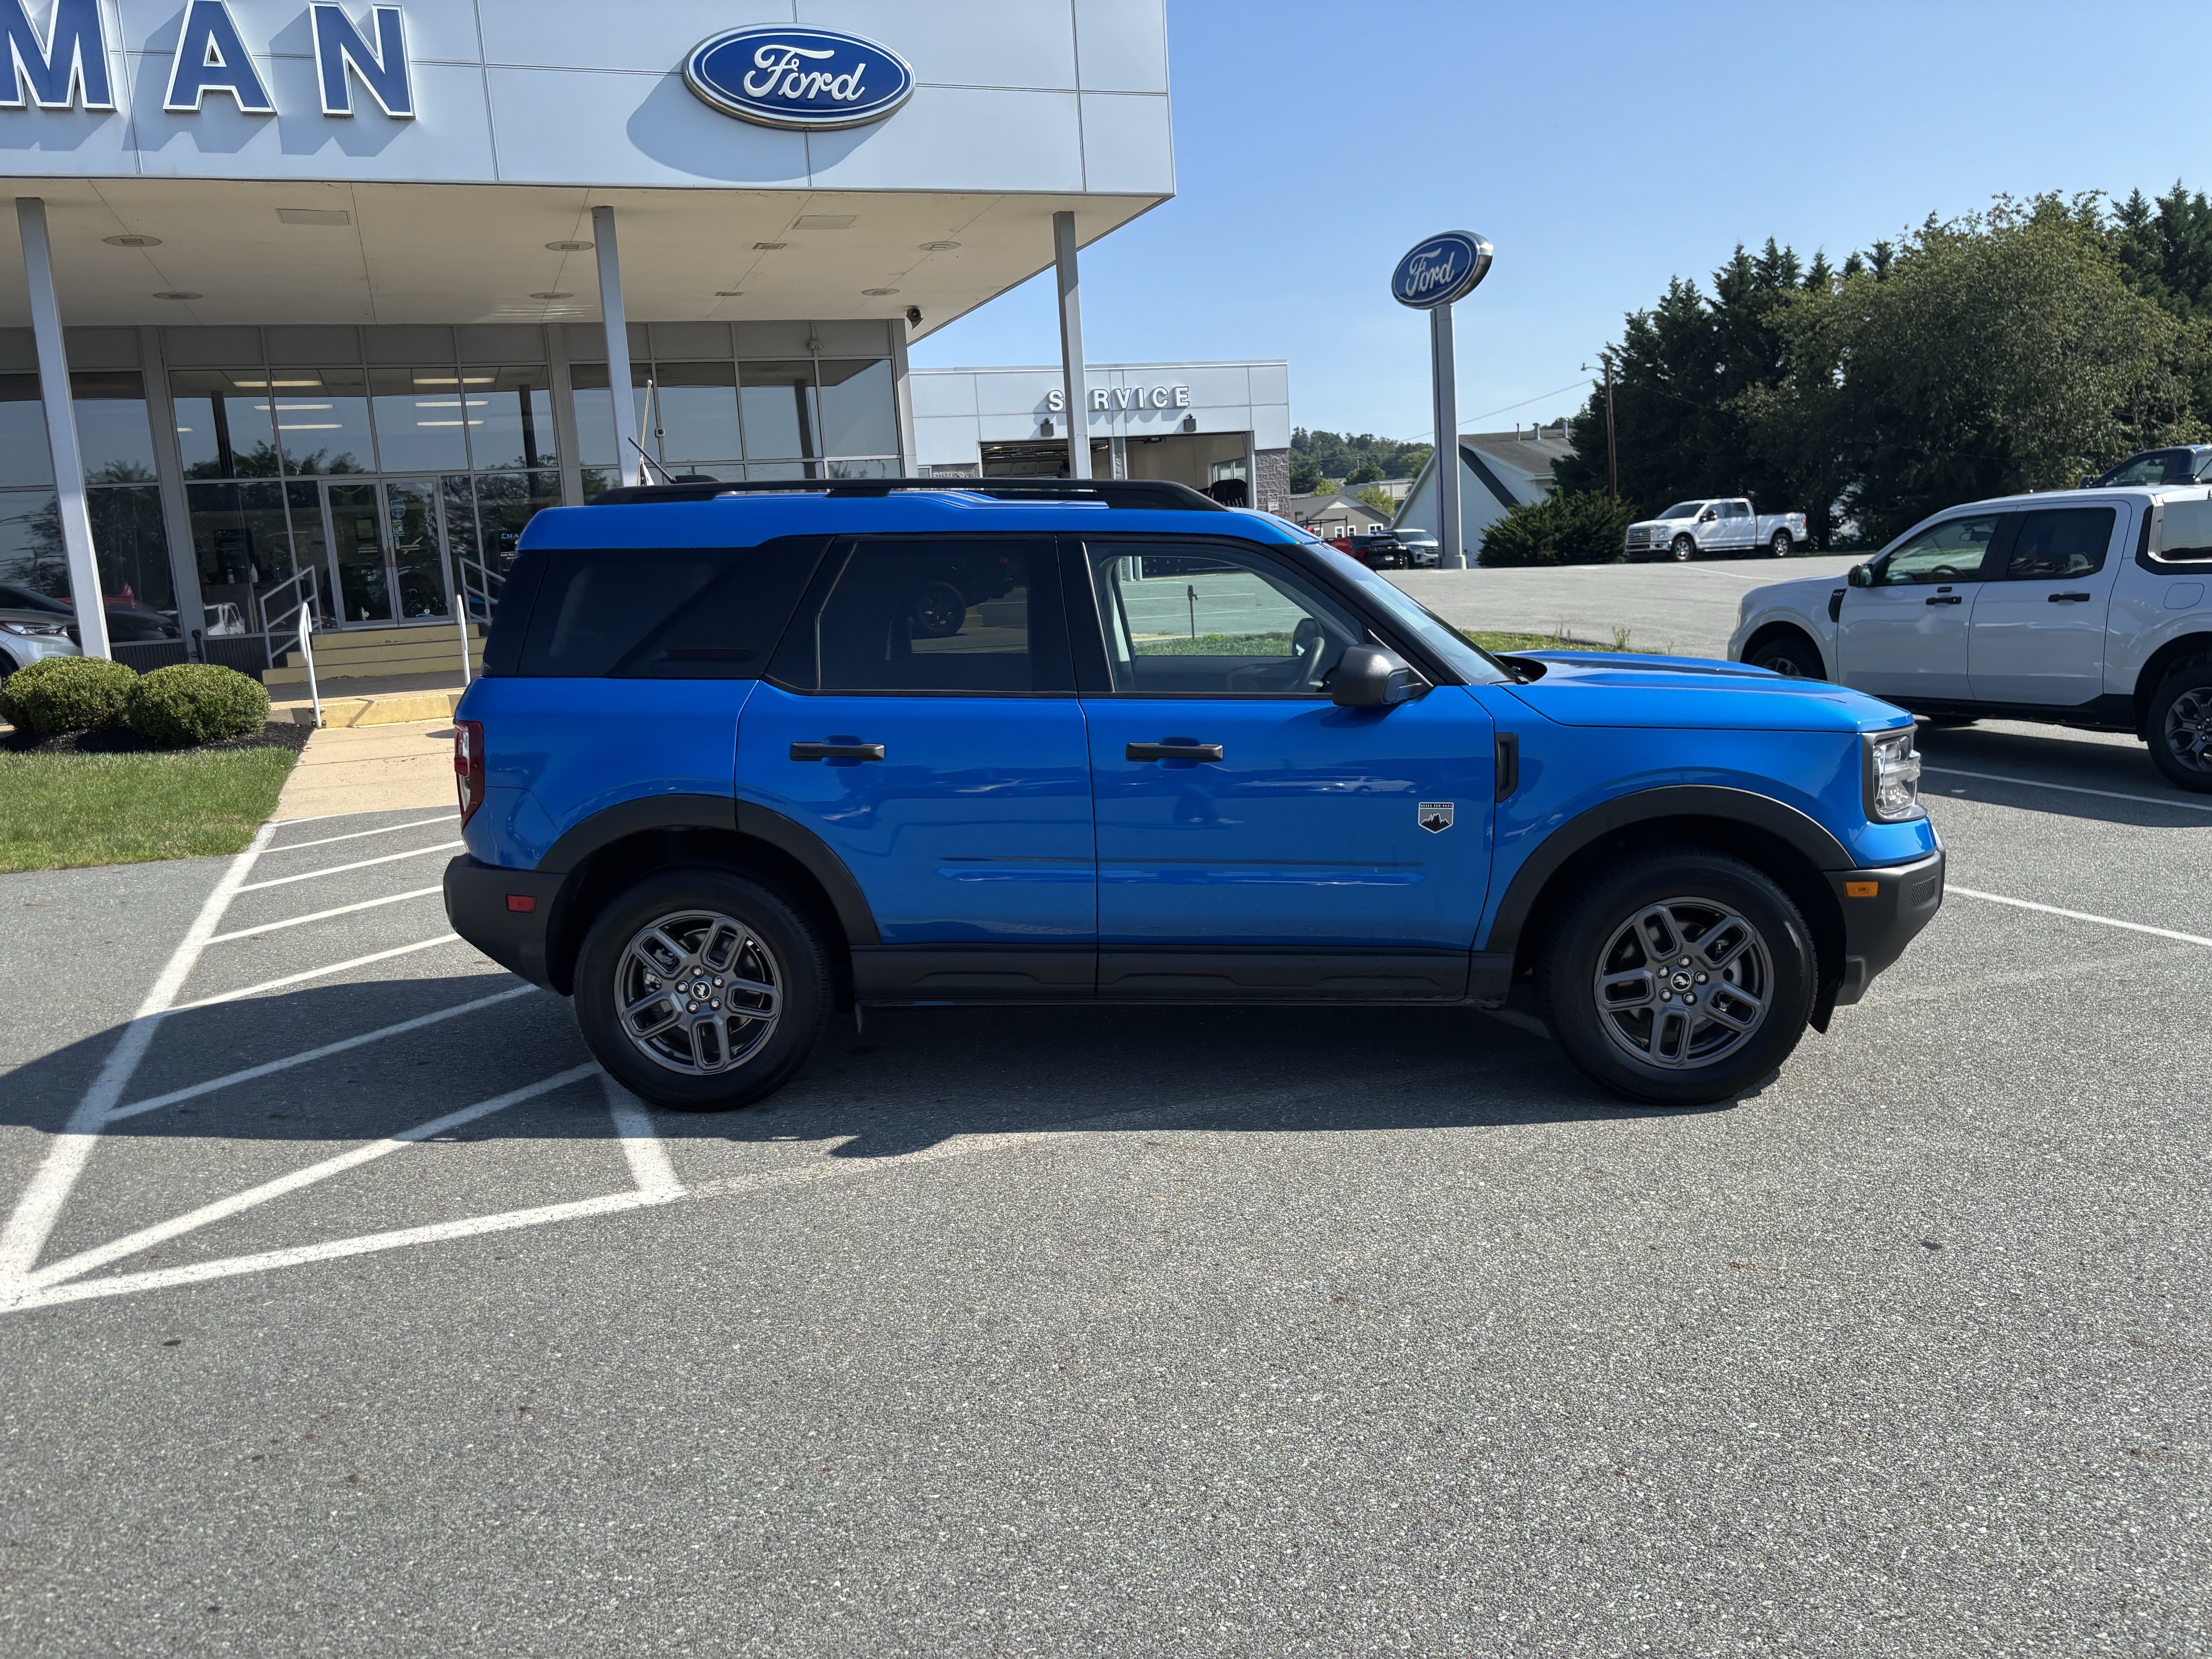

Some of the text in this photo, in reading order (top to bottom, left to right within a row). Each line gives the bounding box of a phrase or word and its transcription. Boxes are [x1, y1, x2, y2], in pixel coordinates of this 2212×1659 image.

[0, 0, 416, 118] MAN
[744, 44, 866, 101] Ford
[1406, 247, 1455, 297] Ford
[1047, 386, 1190, 411] SRVICE
